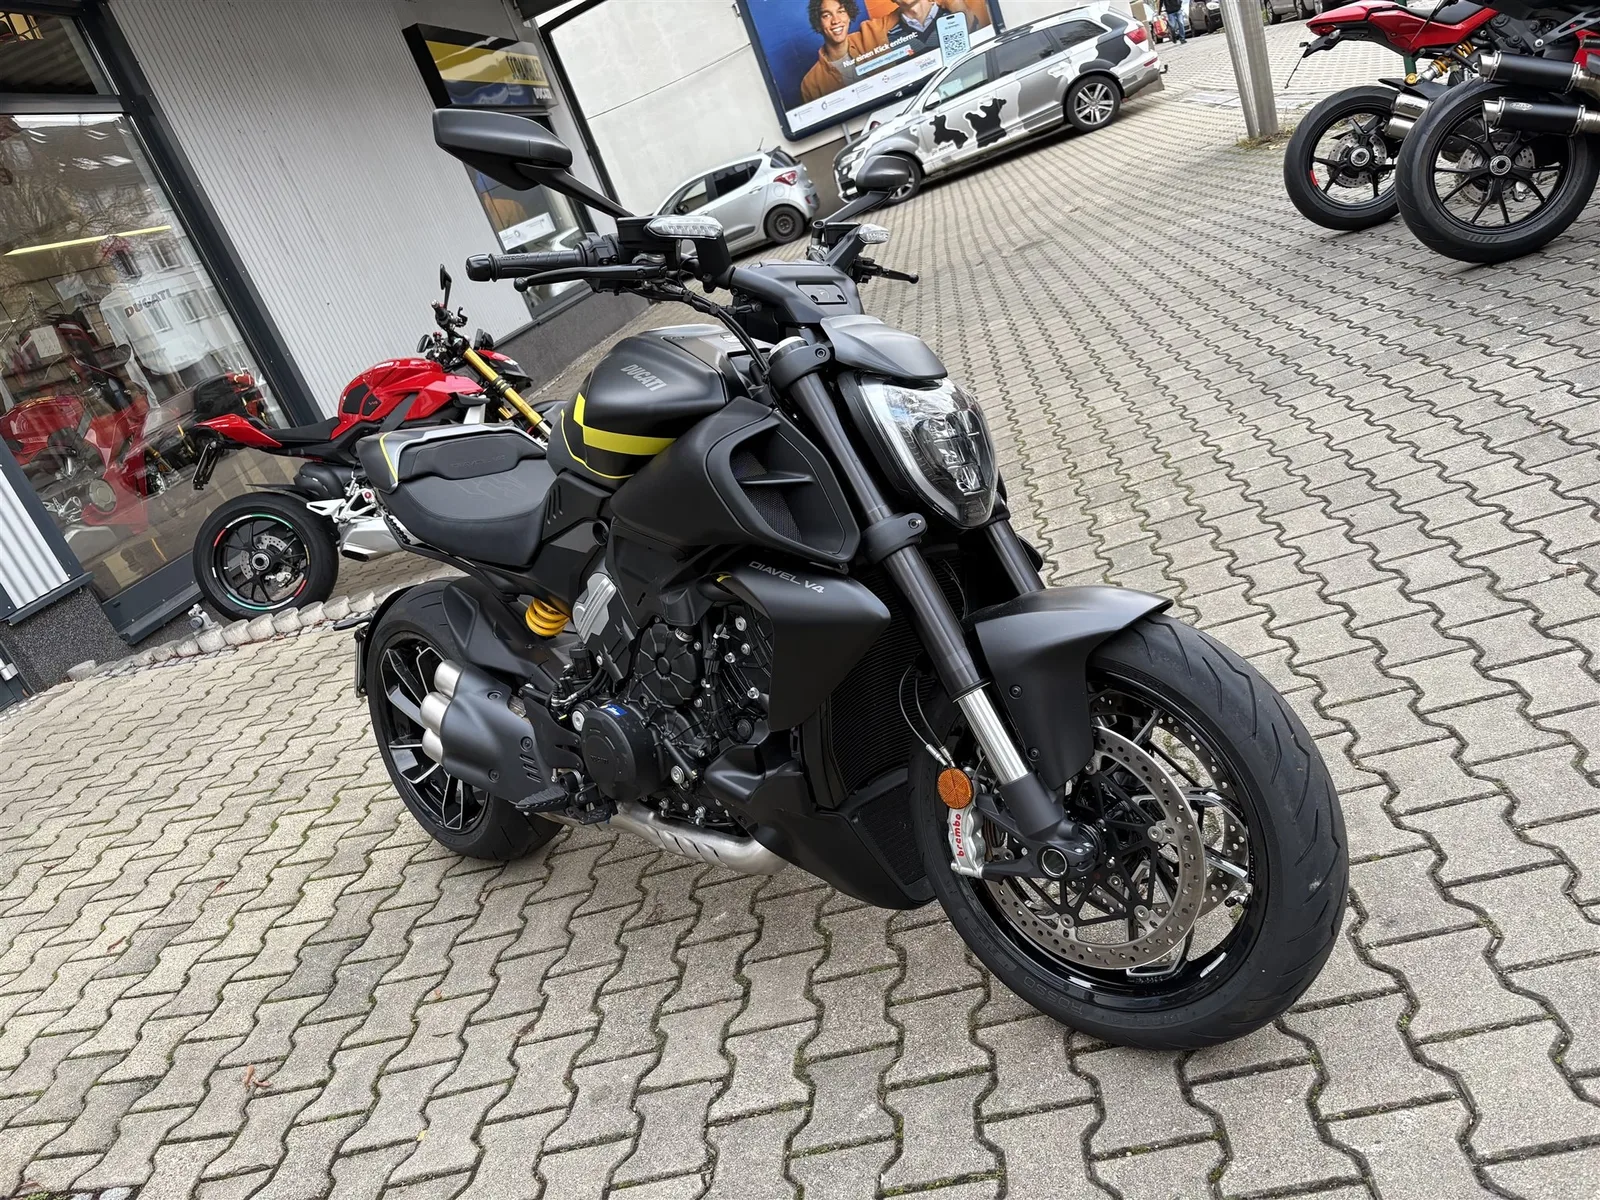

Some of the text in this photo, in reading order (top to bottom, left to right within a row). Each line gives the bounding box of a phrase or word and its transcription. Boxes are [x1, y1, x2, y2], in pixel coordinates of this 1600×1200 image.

[842, 31, 919, 68] Nur einen Klick entfernt:
[124, 288, 172, 319] DUCATI
[620, 363, 667, 392] DUCATI
[748, 560, 825, 594] DIAVEL V4
[952, 813, 965, 857] brembo
[1023, 975, 1084, 1016] ROSSO
